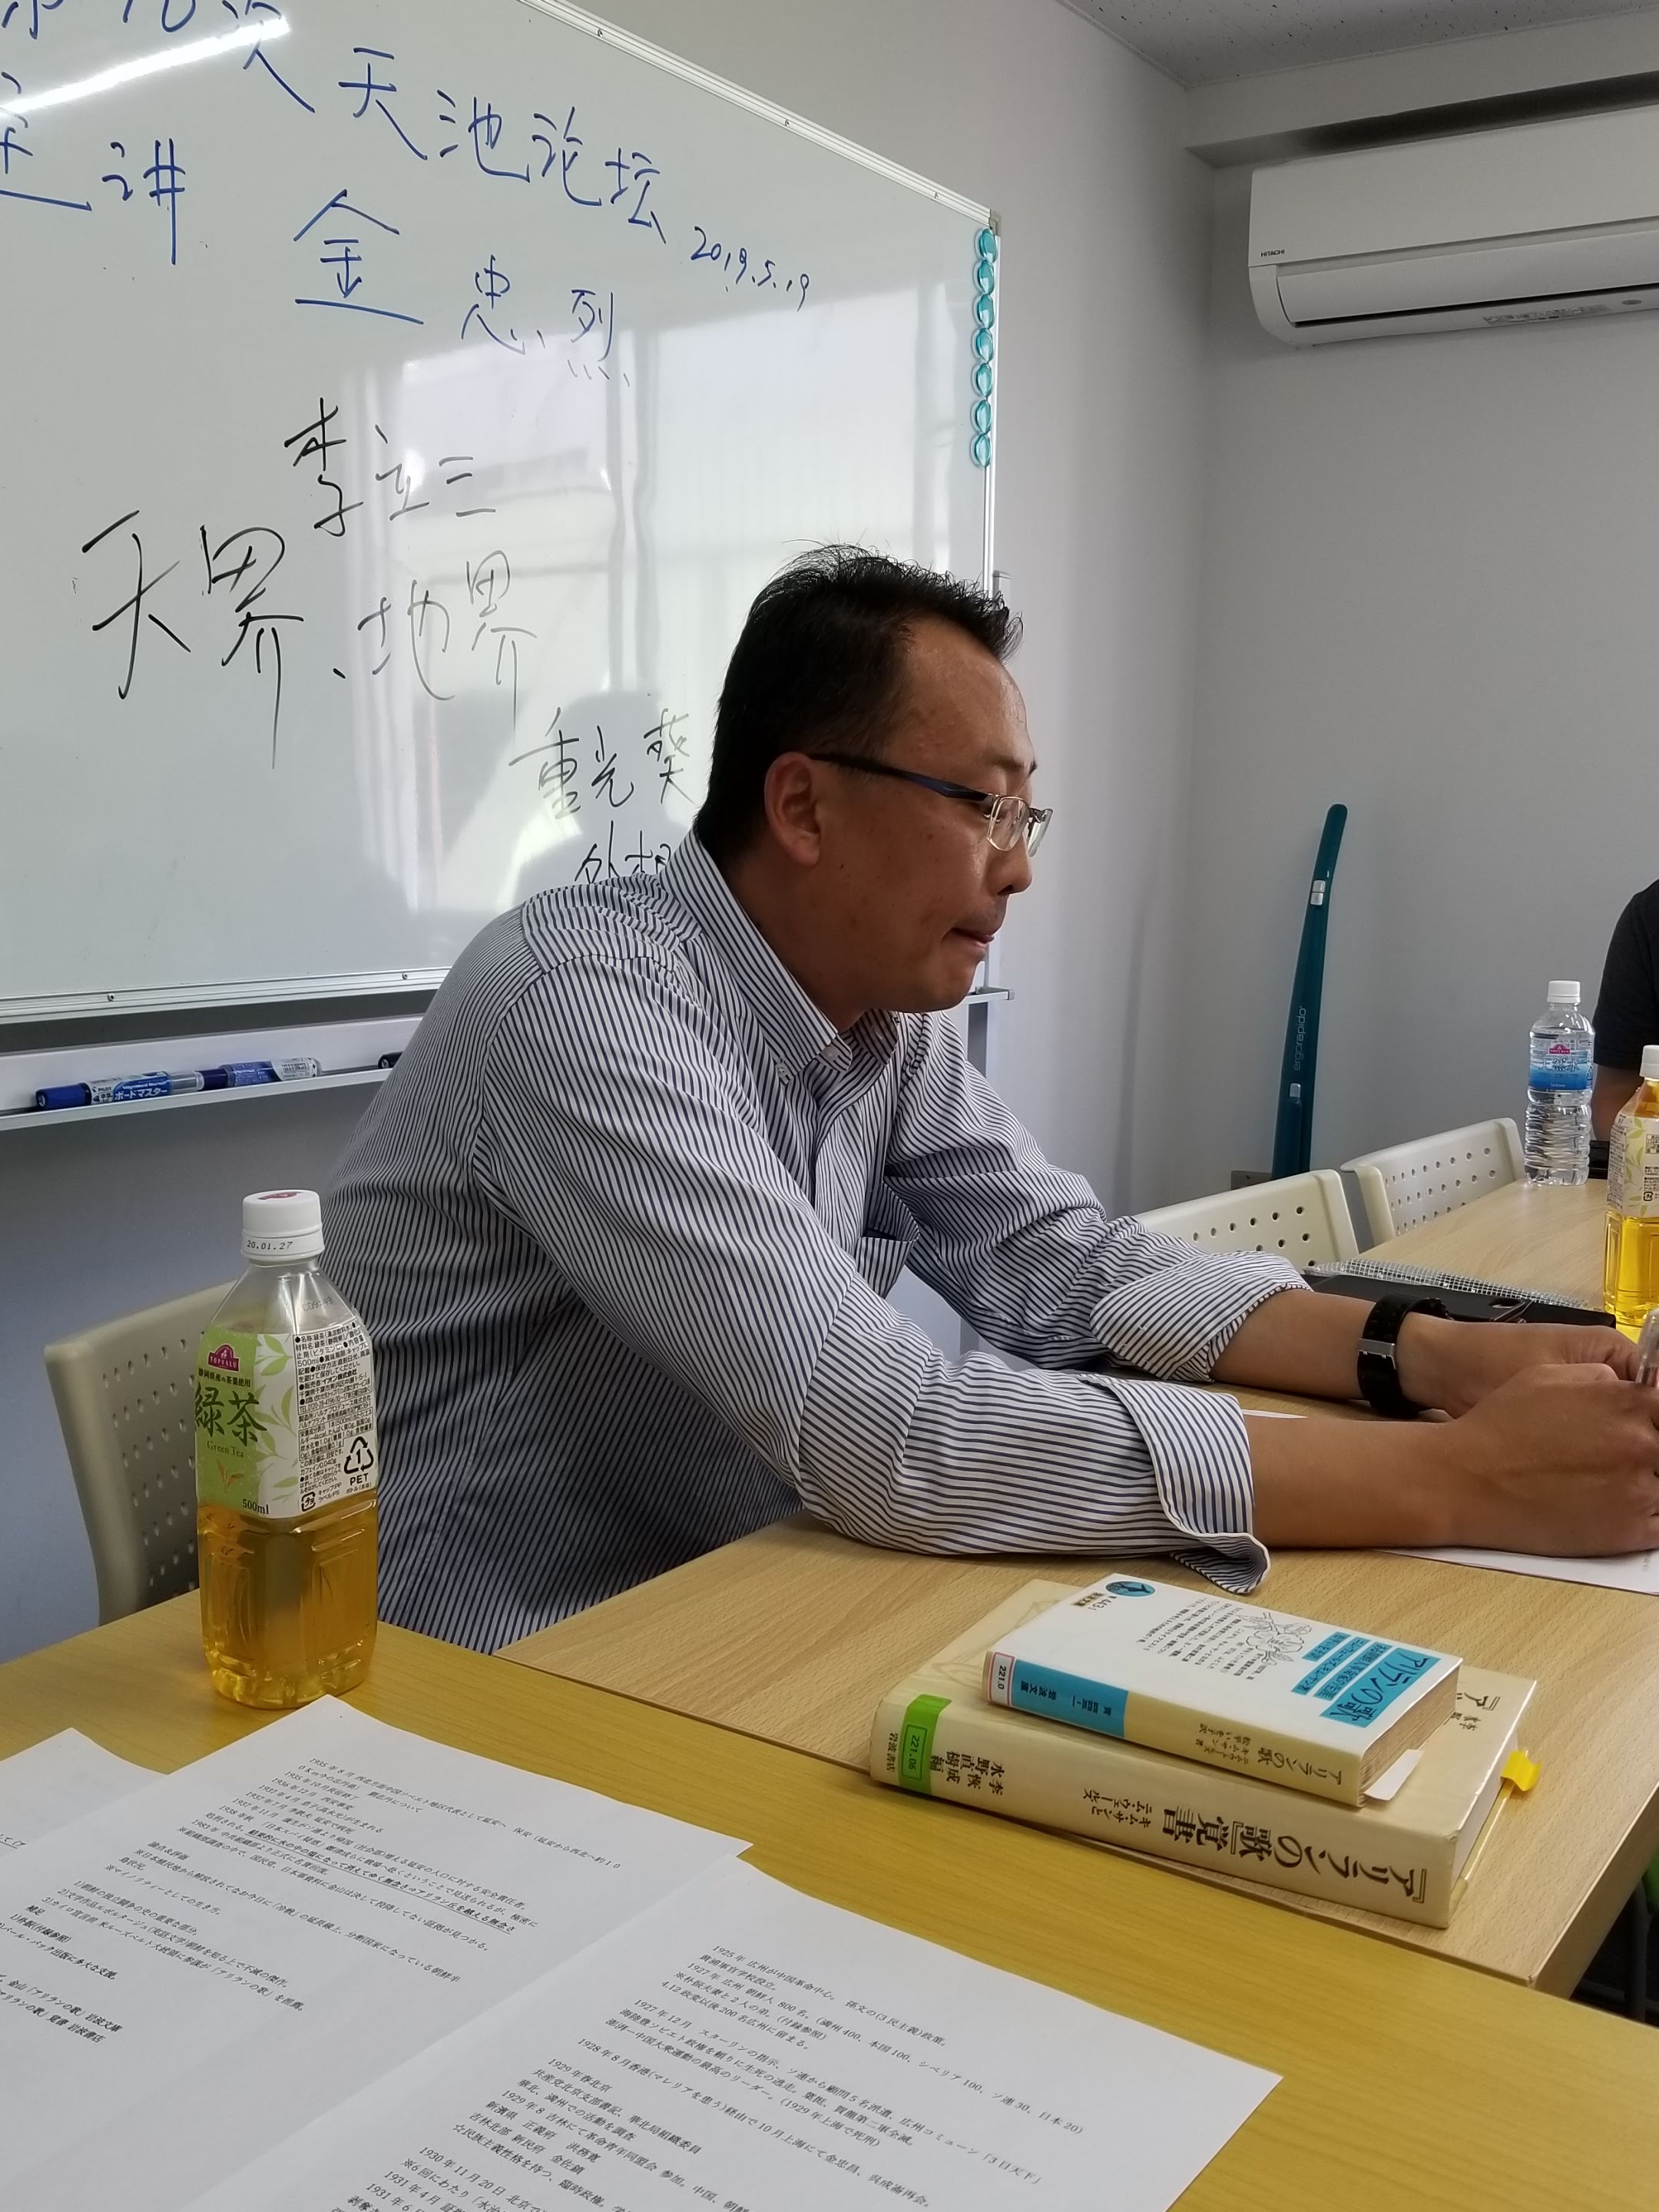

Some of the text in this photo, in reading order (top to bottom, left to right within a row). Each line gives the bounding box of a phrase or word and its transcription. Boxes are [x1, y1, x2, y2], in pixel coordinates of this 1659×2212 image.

[1260, 249, 1285, 257] HITACHI
[1293, 1007, 1306, 1071] ergorapido
[114, 1087, 168, 1101] ボードマスター
[247, 1240, 293, 1250] 20.01.27
[209, 1355, 238, 1369] TOPVALU
[195, 1381, 268, 1448] 緑茶
[207, 1440, 244, 1459] Green Tea
[349, 1472, 369, 1486] PET
[242, 1498, 270, 1515] 500ml
[998, 1665, 1007, 1690] 221.0
[1330, 1652, 1429, 1721] アリランの歌
[1020, 1680, 1058, 1701] 岩波文庫
[908, 1734, 920, 1771] 221.06
[1257, 1747, 1343, 1786] アリランの歌
[1082, 1786, 1153, 1815] ニム・ウェールズ
[1091, 1805, 1153, 1830] キム・サンと
[548, 2058, 613, 2093] 1929年春北京
[522, 2120, 558, 2140] 正義府
[512, 2134, 546, 2154] 新民府
